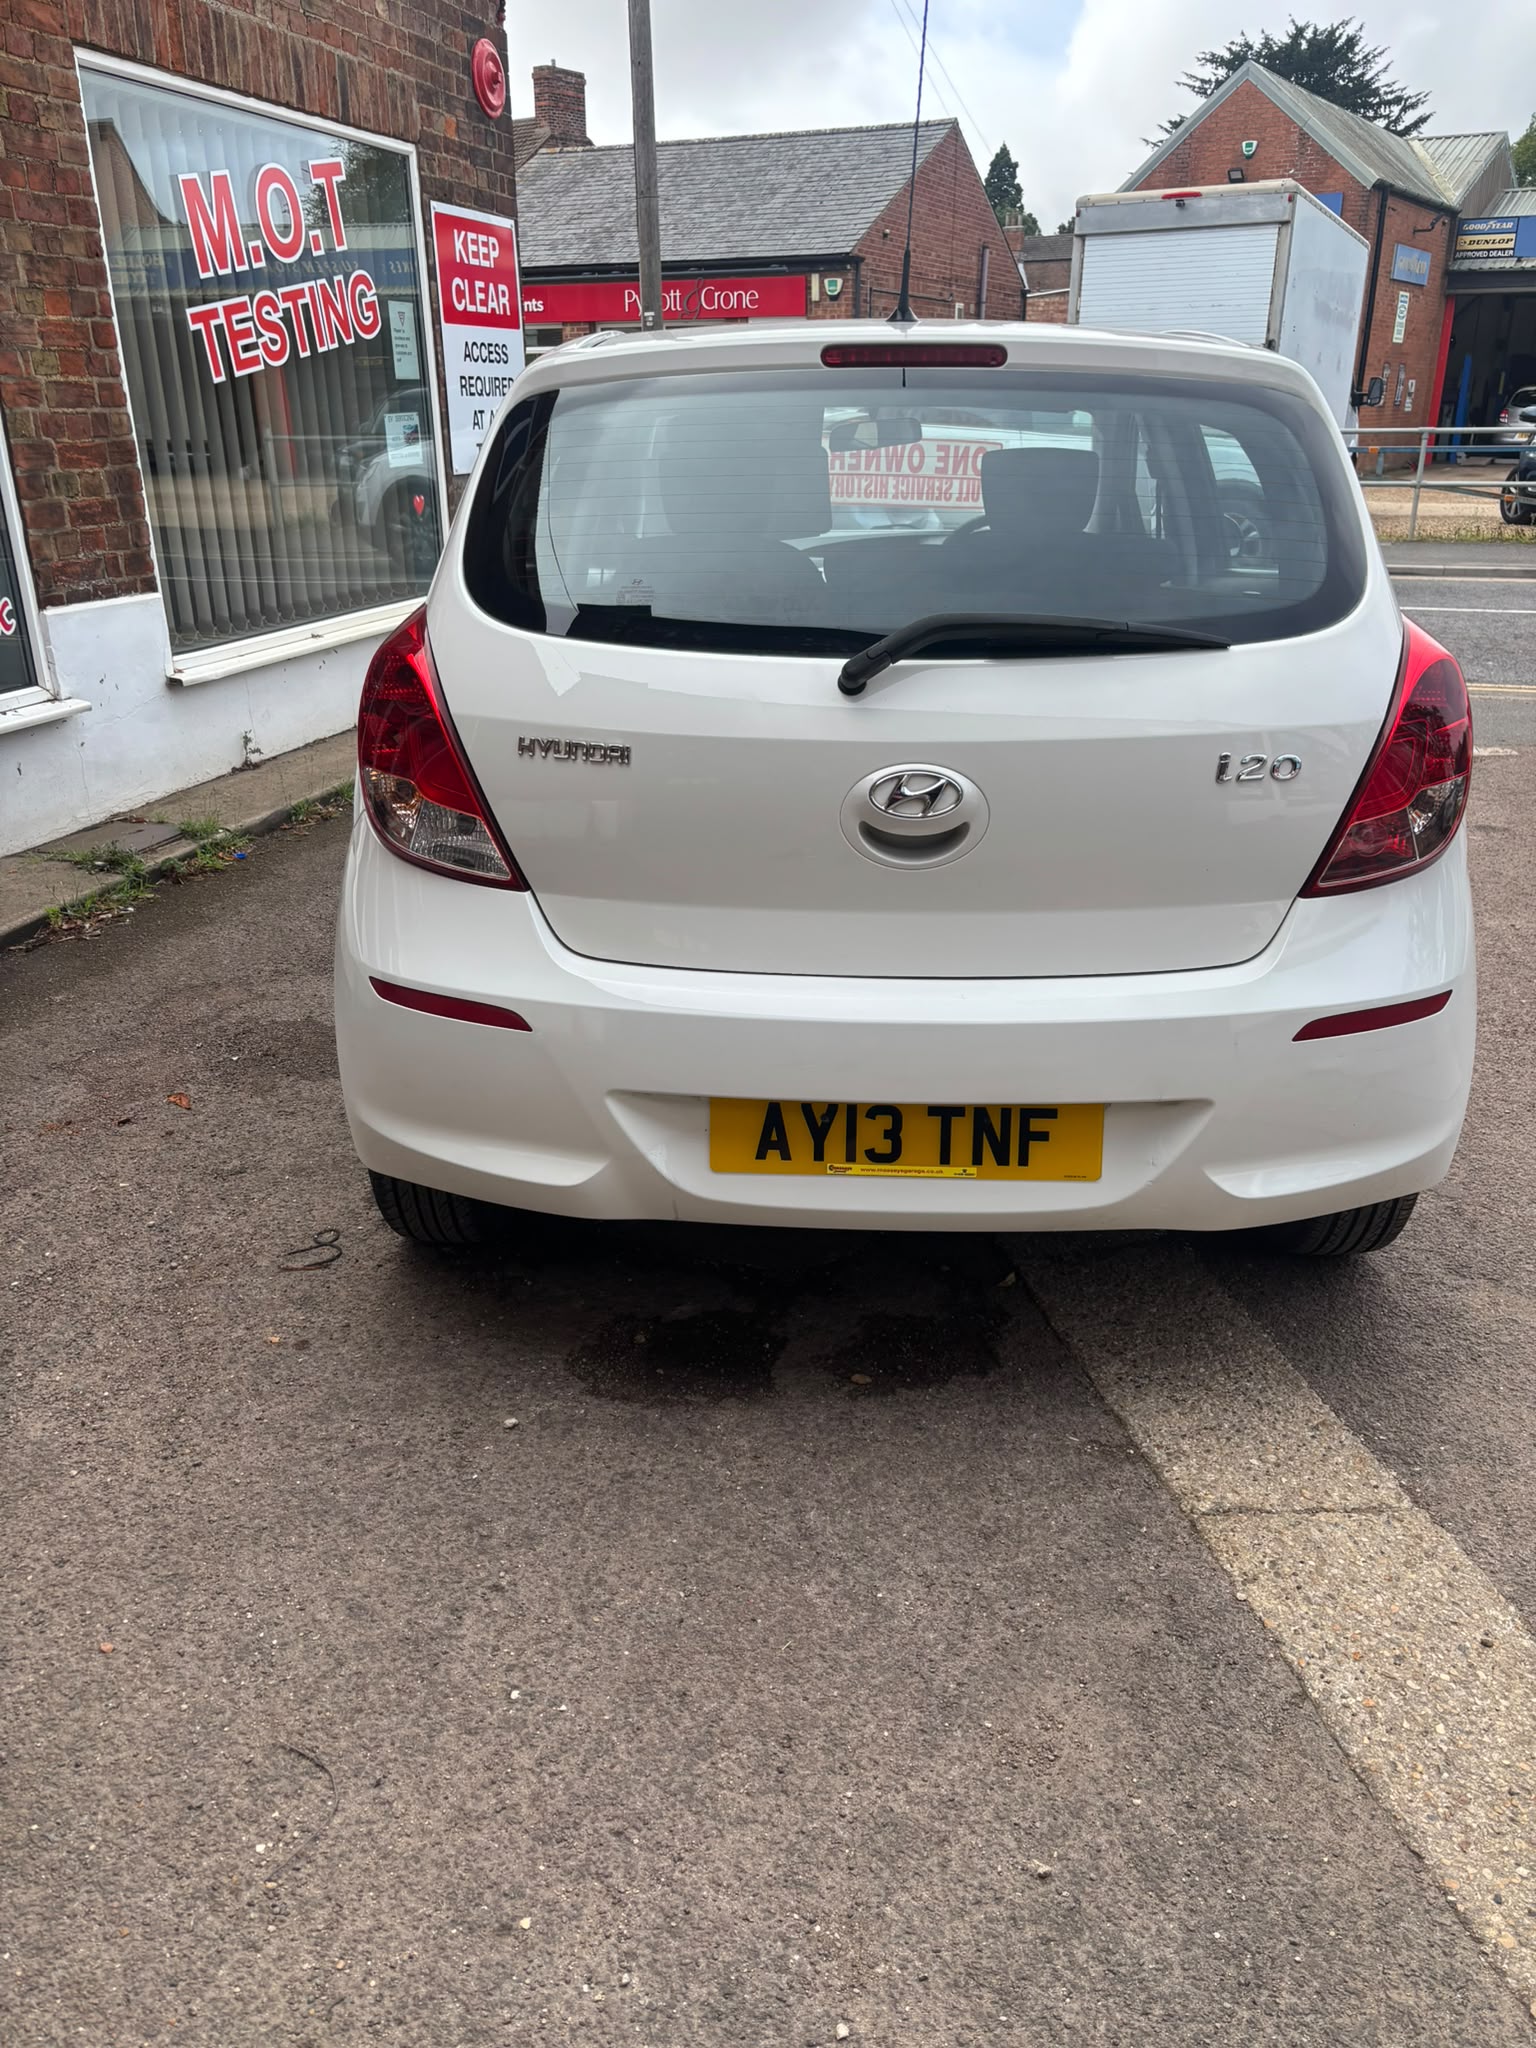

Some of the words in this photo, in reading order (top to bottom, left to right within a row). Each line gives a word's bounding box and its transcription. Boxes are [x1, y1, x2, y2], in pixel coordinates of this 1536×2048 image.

[178, 157, 348, 279] M.O.T
[1462, 221, 1514, 231] GOODYEAR
[453, 228, 500, 269] KEEP
[1455, 251, 1488, 259] APPROVED
[1467, 238, 1514, 246] DUNLOP
[451, 277, 511, 316] CLEAR
[523, 298, 545, 312] nts
[624, 289, 681, 317] Pyott
[701, 286, 759, 310] Crone
[185, 269, 382, 384] TESTING
[463, 341, 509, 365] ACCESS
[472, 410, 485, 430] AT
[518, 735, 631, 766] HYUNDAI
[1215, 752, 1302, 784] i20
[754, 1102, 903, 1164] AY13
[927, 1105, 1059, 1167] TNF
